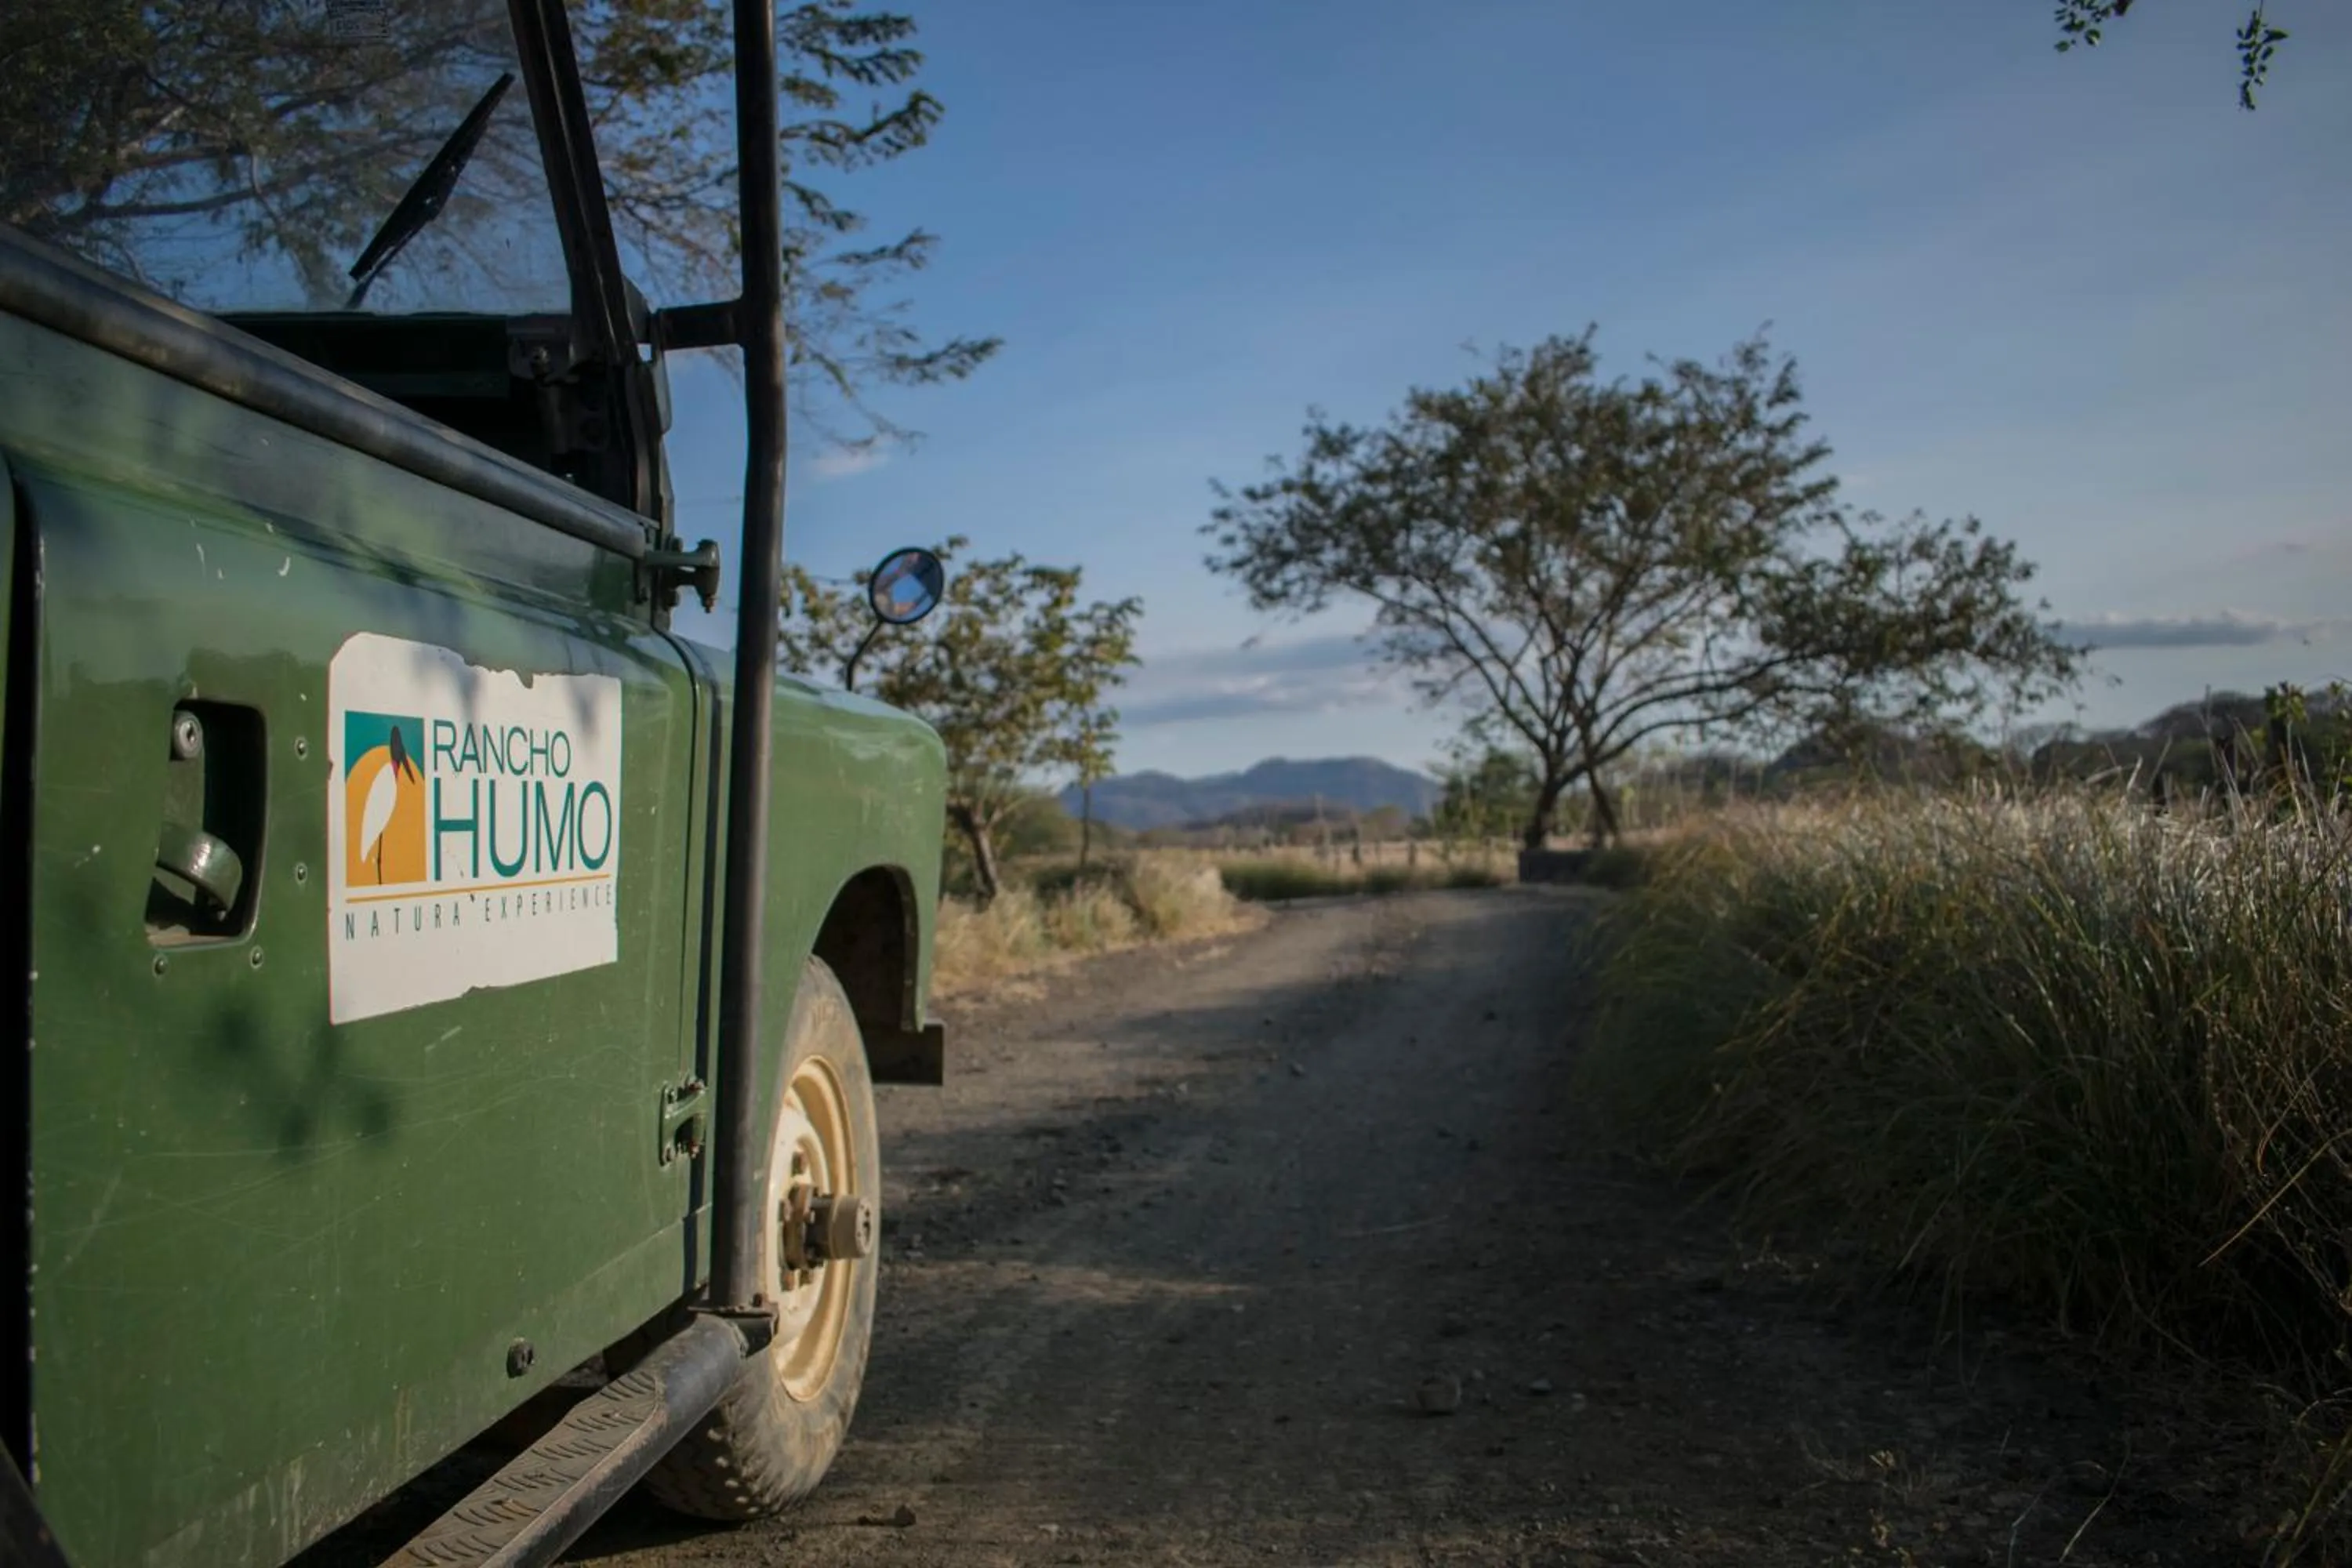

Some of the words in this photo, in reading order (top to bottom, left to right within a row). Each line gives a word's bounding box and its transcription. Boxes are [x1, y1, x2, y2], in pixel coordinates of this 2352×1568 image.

[434, 719, 571, 778] RANCHO
[434, 777, 612, 882] HUMO
[485, 884, 612, 922] EXPERIENCE
